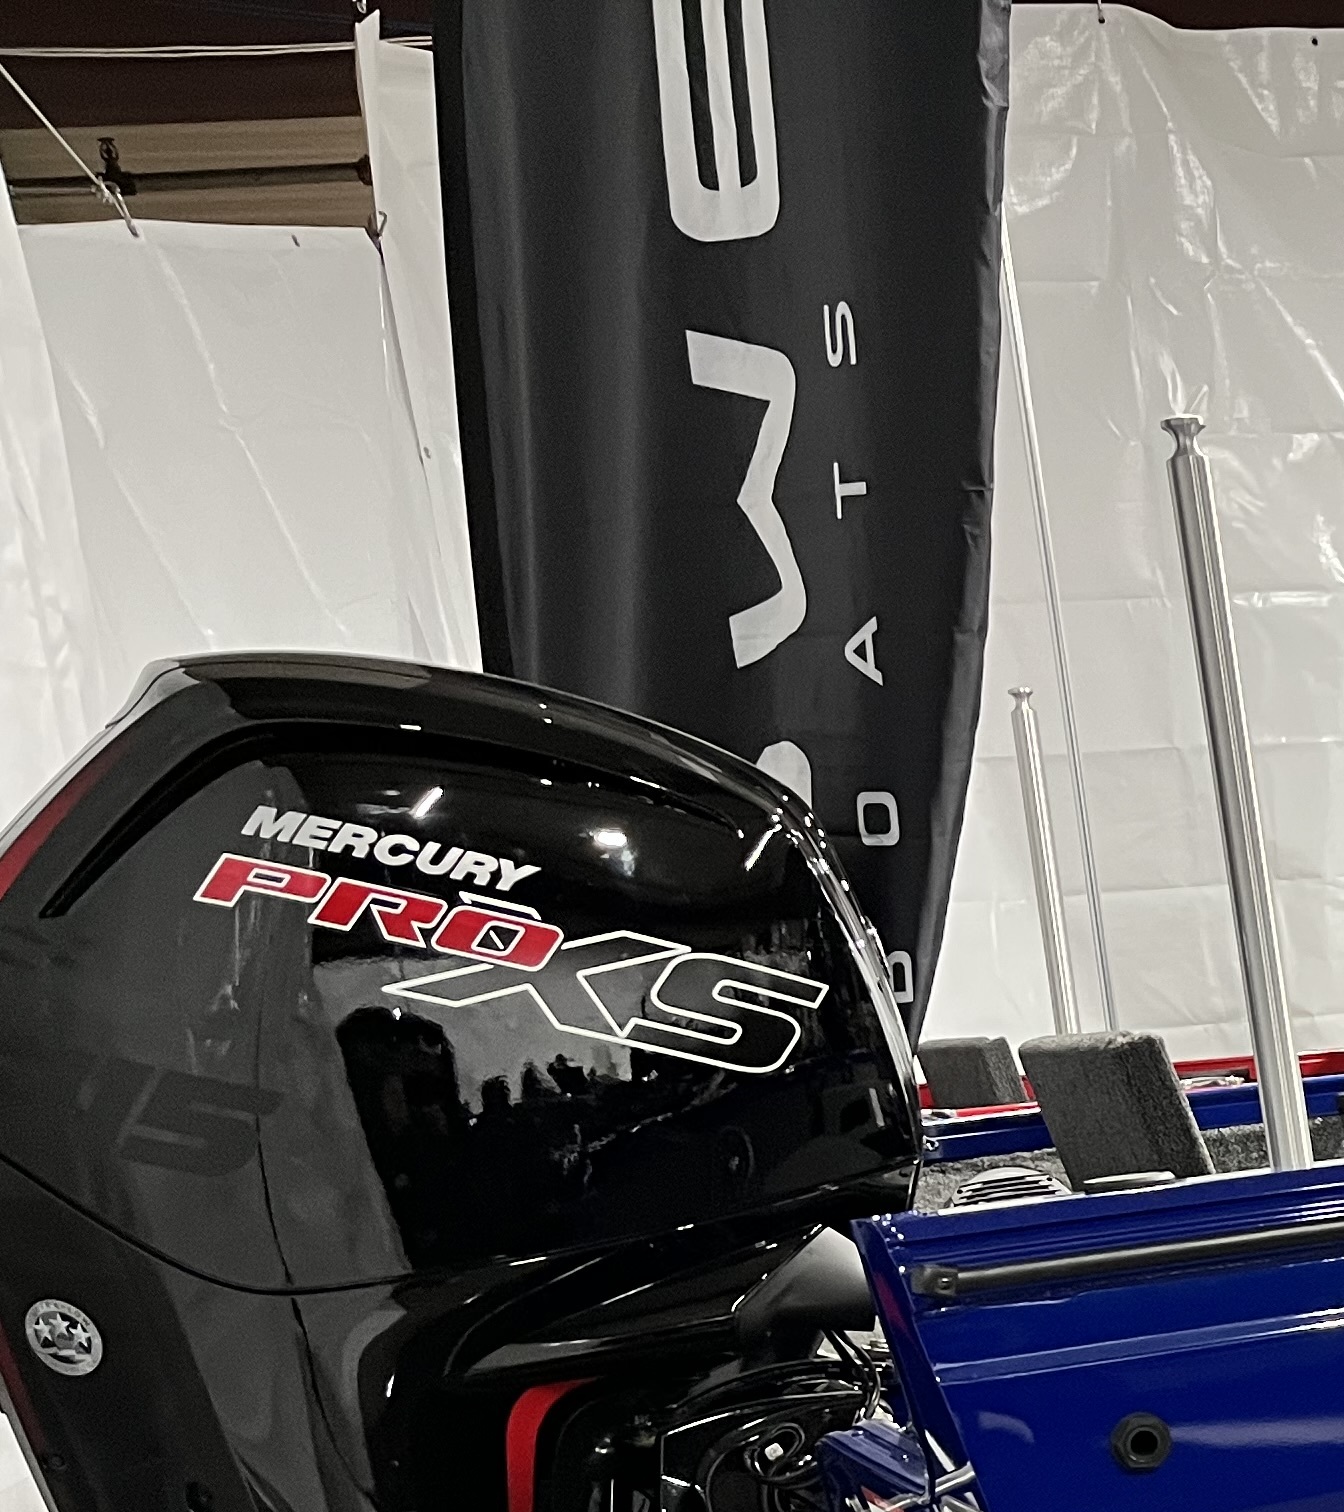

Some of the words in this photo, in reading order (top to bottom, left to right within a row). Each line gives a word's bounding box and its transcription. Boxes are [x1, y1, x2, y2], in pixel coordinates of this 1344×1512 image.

[652, 0, 812, 807] WE
[241, 804, 542, 892] MERCURY
[193, 852, 564, 971] PRO
[382, 929, 830, 1074] XS
